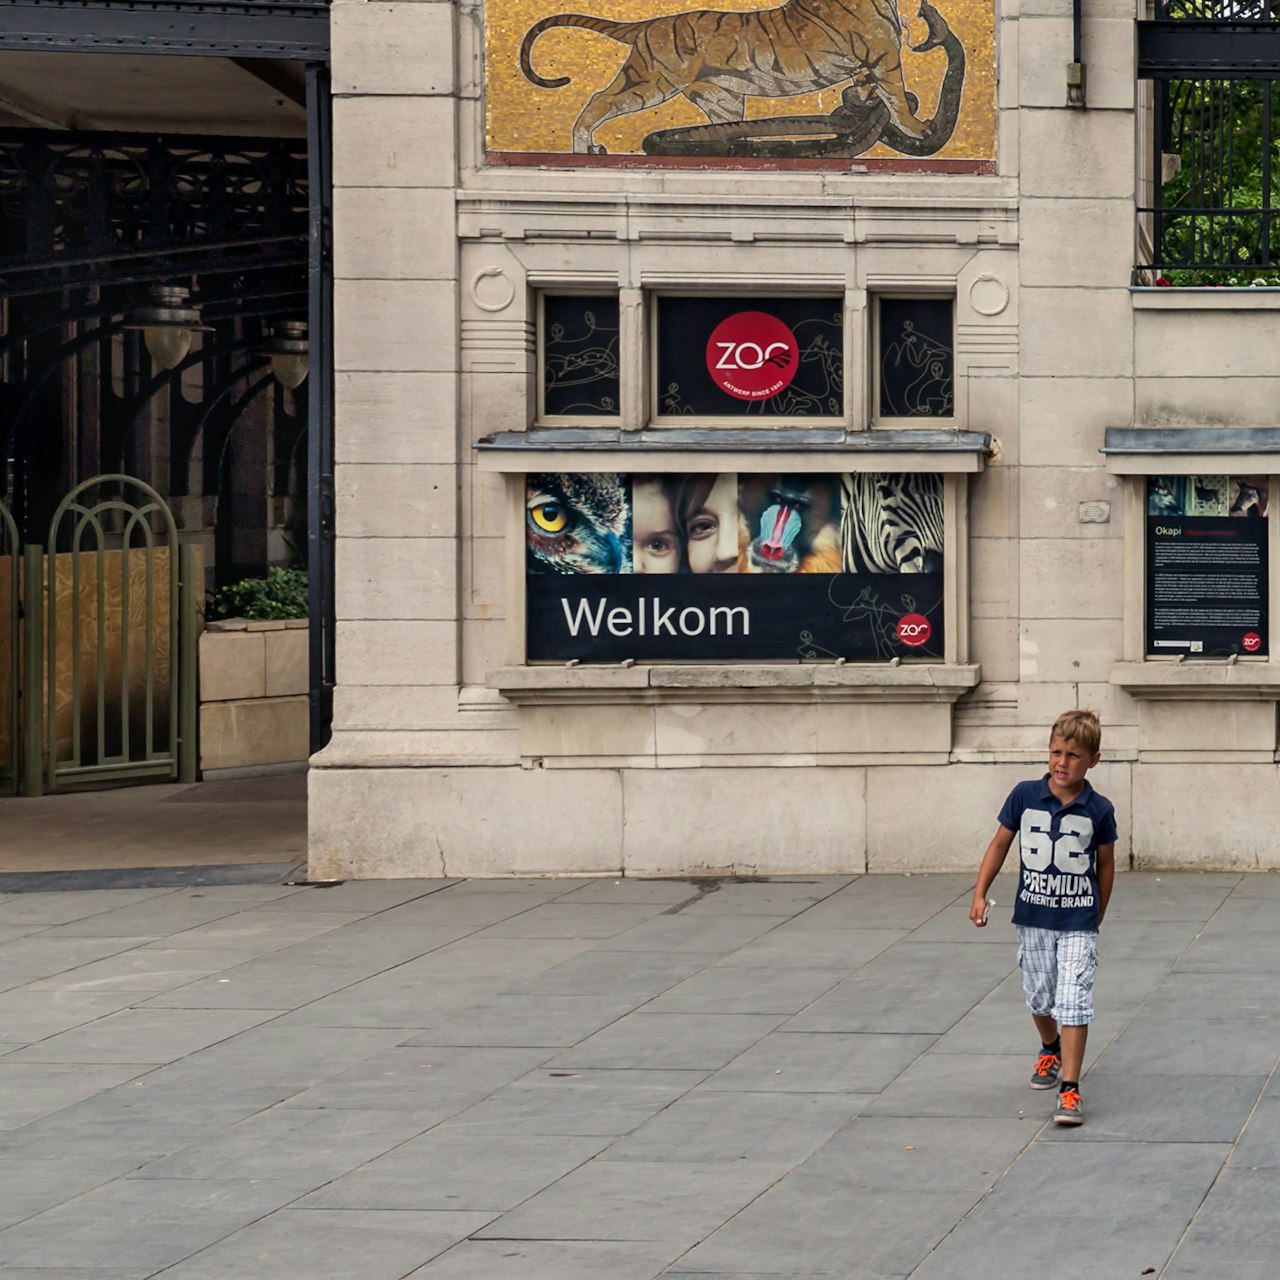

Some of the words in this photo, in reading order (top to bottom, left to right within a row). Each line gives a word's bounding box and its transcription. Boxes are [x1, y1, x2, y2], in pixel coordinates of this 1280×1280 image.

[723, 381, 750, 396] ANTWERP
[752, 389, 770, 397] SINCE
[1155, 526, 1181, 536] Okapi
[560, 596, 751, 639] Welkom
[1020, 808, 1094, 874] 62
[1023, 869, 1092, 895] PREMIUM
[1020, 889, 1059, 908] AUTHENTIC
[1061, 895, 1093, 908] BRAND
